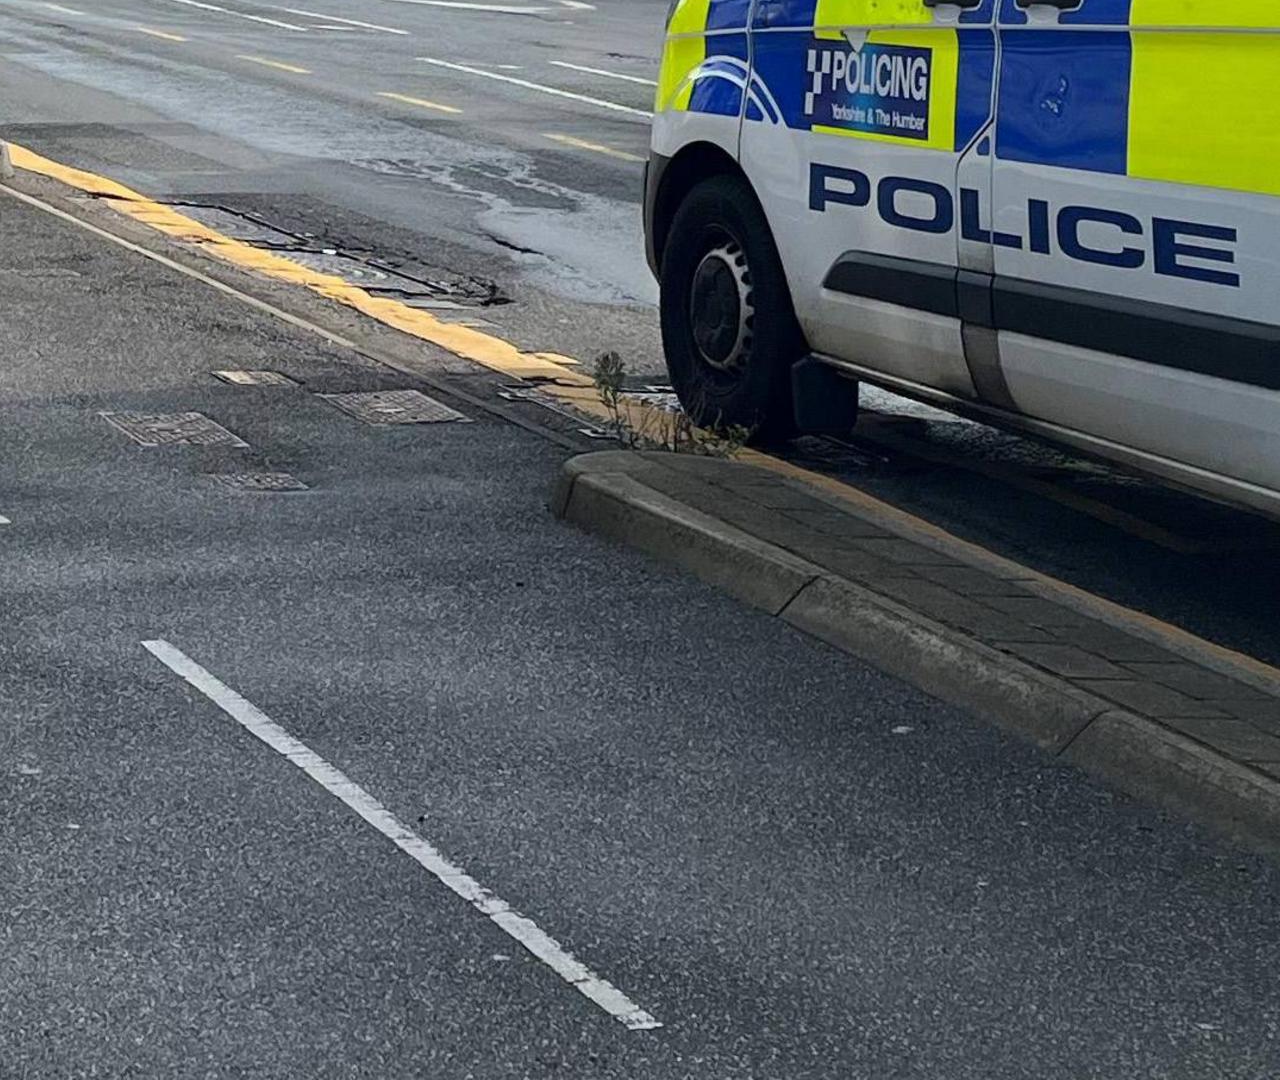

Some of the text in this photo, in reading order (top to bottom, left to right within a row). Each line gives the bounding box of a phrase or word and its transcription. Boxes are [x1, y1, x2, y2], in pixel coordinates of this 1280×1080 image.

[832, 50, 928, 101] POLICING
[866, 107, 874, 125] &
[875, 108, 891, 127] The
[891, 111, 926, 131] Humber
[809, 162, 1241, 288] POLICE
